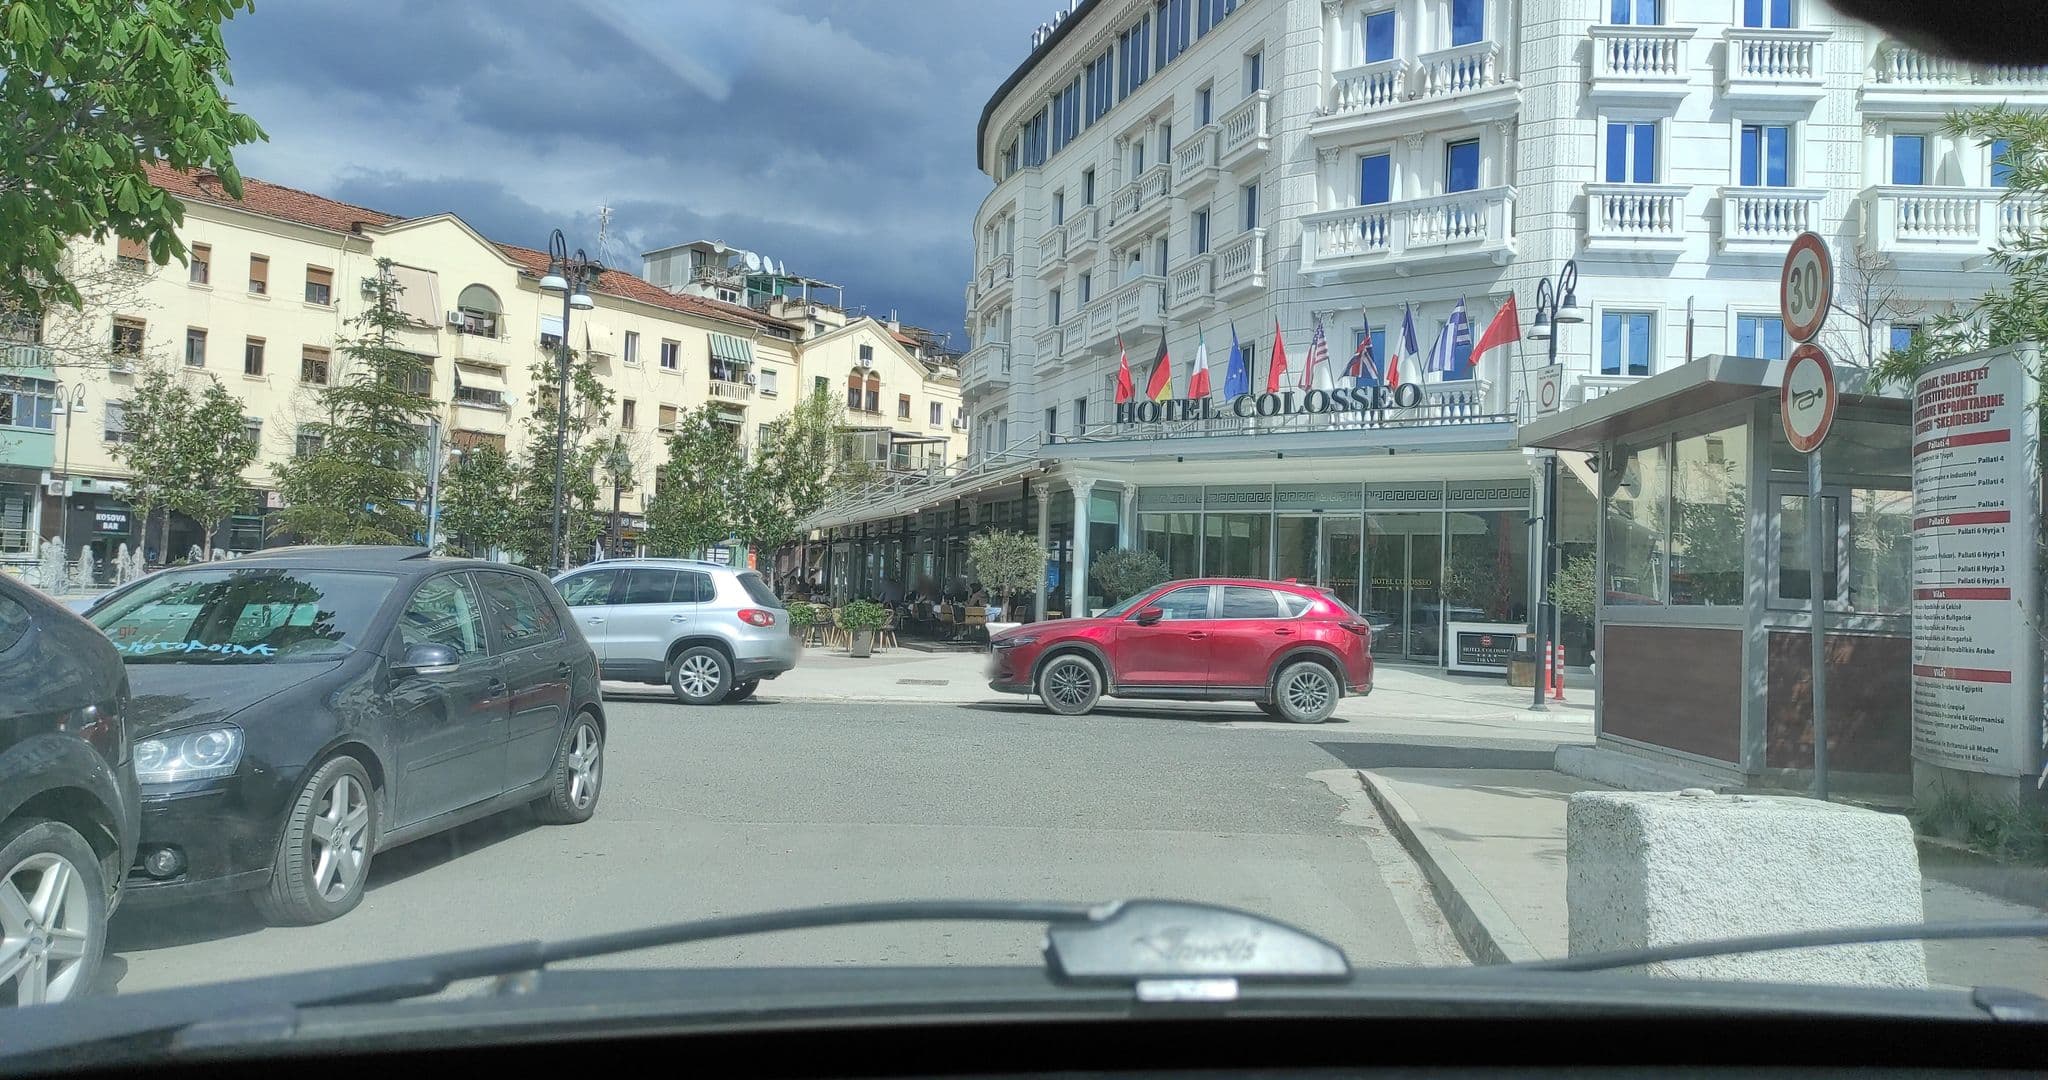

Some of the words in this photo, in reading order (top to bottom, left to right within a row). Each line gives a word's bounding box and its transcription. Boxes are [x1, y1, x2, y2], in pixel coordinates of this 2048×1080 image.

[1790, 261, 1818, 315] 30
[1940, 367, 1989, 387] SUBJEKTET
[1116, 396, 1222, 424] HOTEL
[1234, 382, 1424, 419] COLOSSEO
[1928, 440, 1945, 449] Pallati
[1977, 456, 1999, 464] Pallati
[95, 513, 127, 522] KOSOVA
[1928, 518, 1945, 526] Pallati
[1945, 516, 1950, 524] 6
[102, 522, 119, 530] BAR
[1982, 527, 2000, 535] Hyrja
[1982, 552, 2000, 560] Hyrja
[1981, 565, 2000, 573] Hyrja
[1371, 577, 1394, 585] HOTEL
[1395, 578, 1432, 586] COLOSSEO
[1975, 647, 1995, 655] Arabe
[1976, 745, 1999, 754] Madhe
